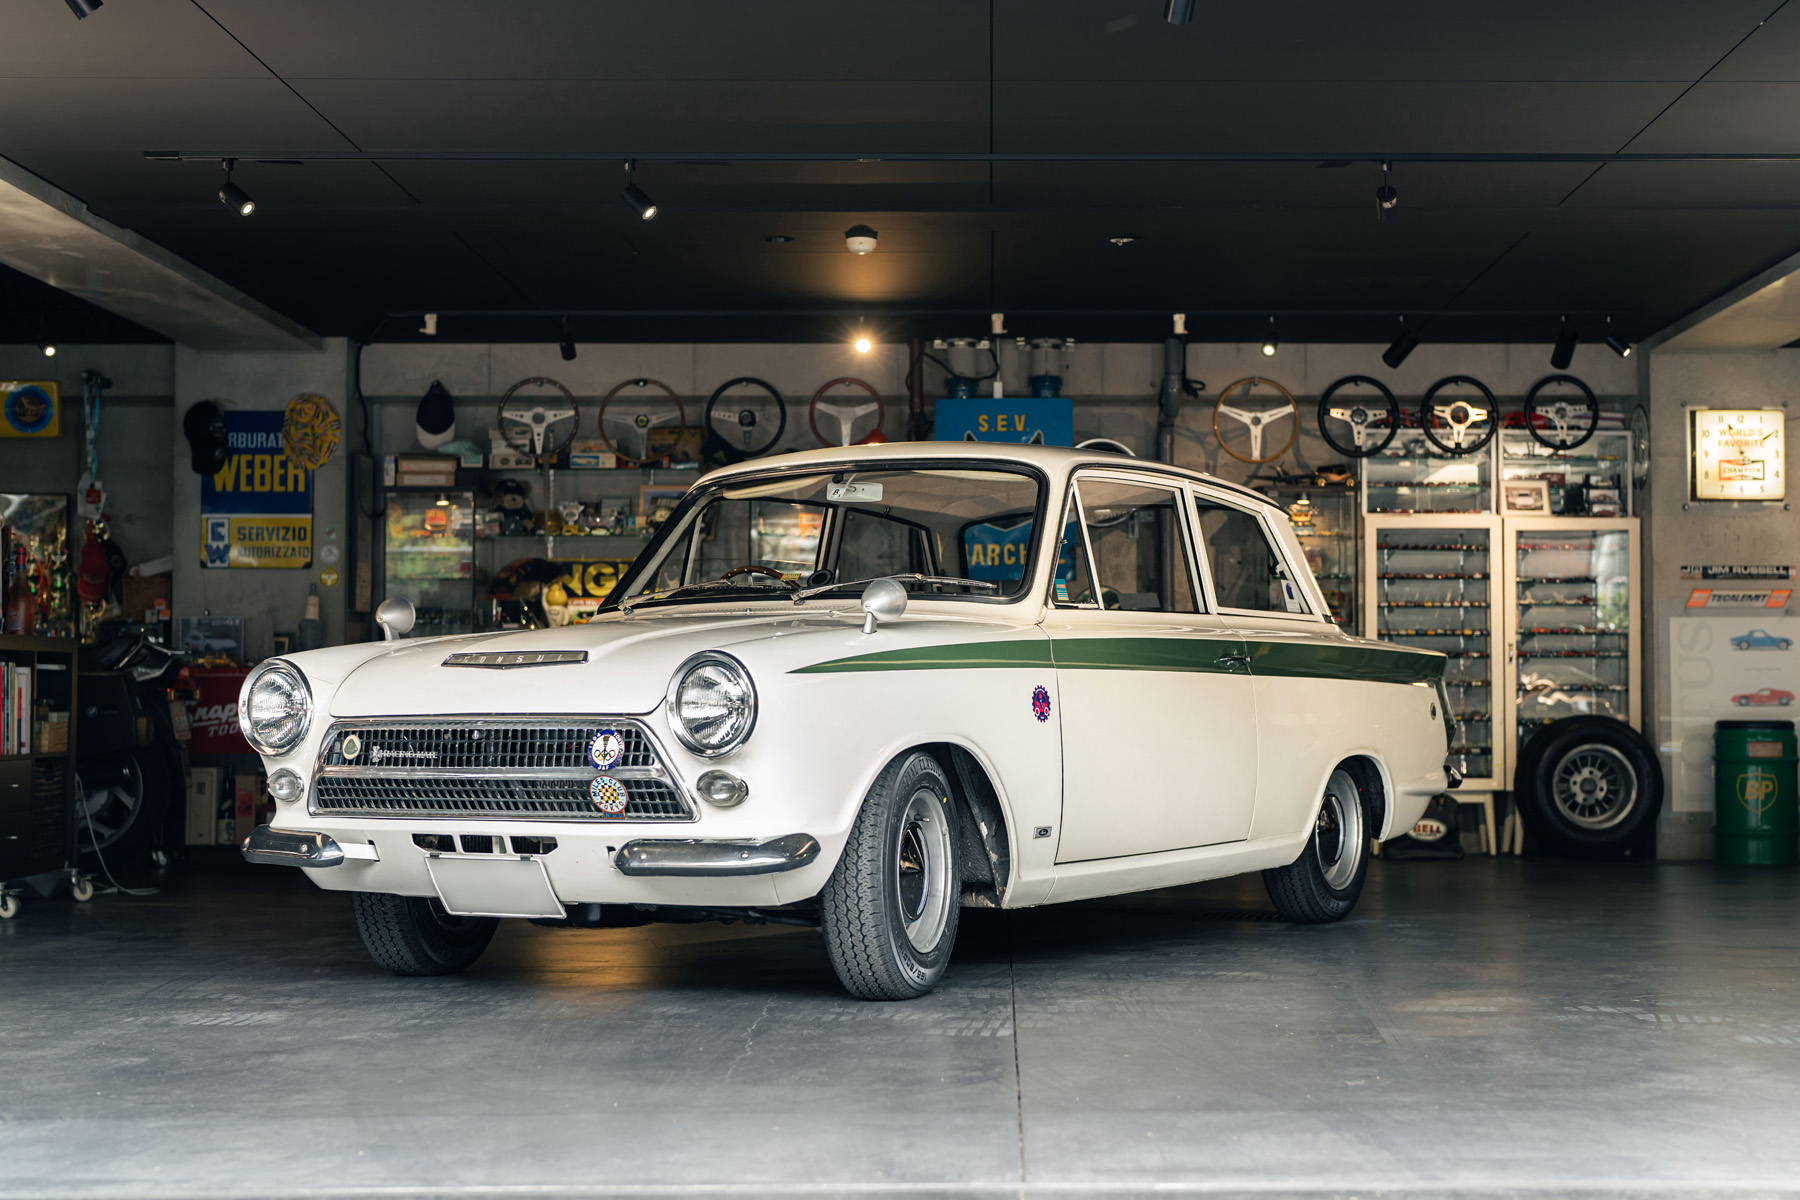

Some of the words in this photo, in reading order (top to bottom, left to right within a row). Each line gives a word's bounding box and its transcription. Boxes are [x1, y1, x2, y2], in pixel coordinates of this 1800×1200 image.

[978, 414, 1030, 432] S.E.V.
[1719, 427, 1763, 437] WORLD'S
[1718, 439, 1764, 448] FAVORITE
[214, 454, 306, 492] WEBER
[237, 526, 307, 542] SERVIZIO
[237, 546, 310, 558] AUTORIZZATO
[1707, 565, 1729, 574] JIM
[1732, 565, 1787, 574] RUSSELL
[592, 777, 605, 797] MILES
[608, 778, 625, 797] CLUB
[1744, 780, 1774, 801] BP
[597, 801, 624, 811] TOKYO
[1413, 824, 1441, 834] BELL
